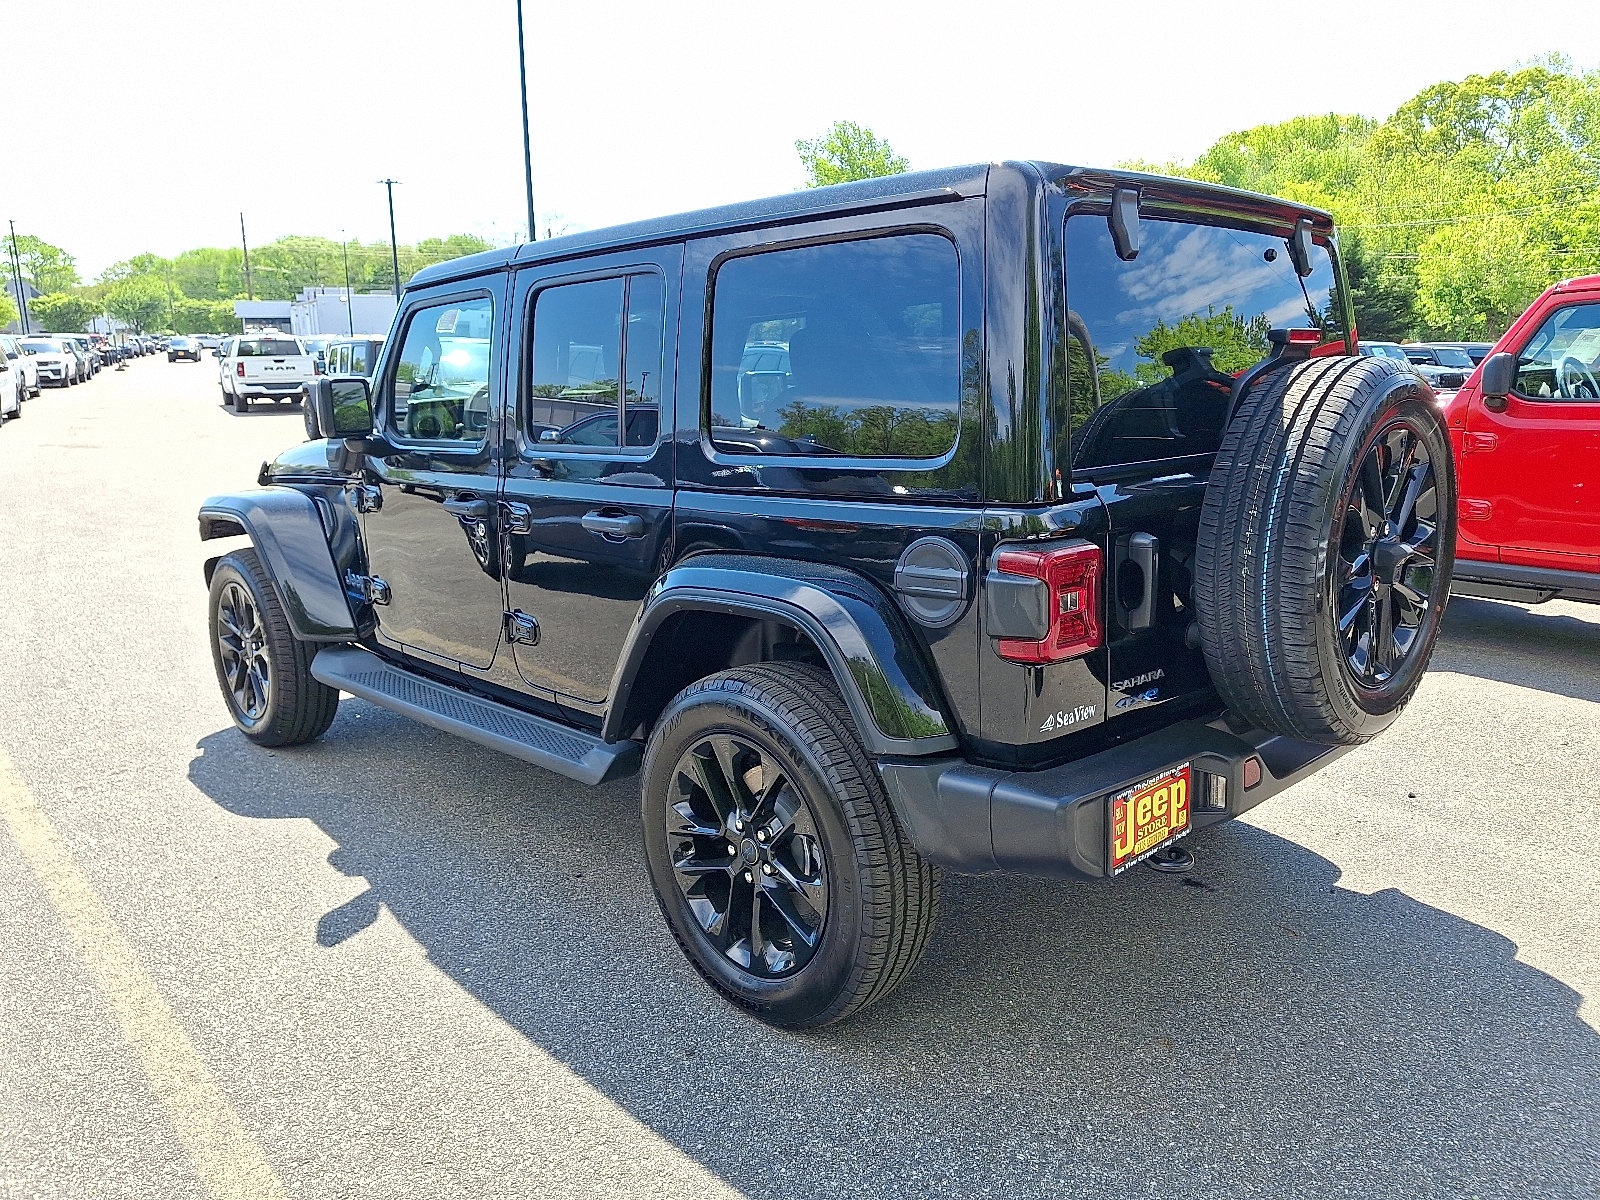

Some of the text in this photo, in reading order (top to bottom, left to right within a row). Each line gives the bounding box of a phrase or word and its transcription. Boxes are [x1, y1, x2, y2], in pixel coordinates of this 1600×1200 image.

[1110, 668, 1165, 692] SAHARA
[736, 704, 804, 767] NEXEN
[1114, 778, 1187, 860] Jeep
[1137, 815, 1168, 840] STORE
